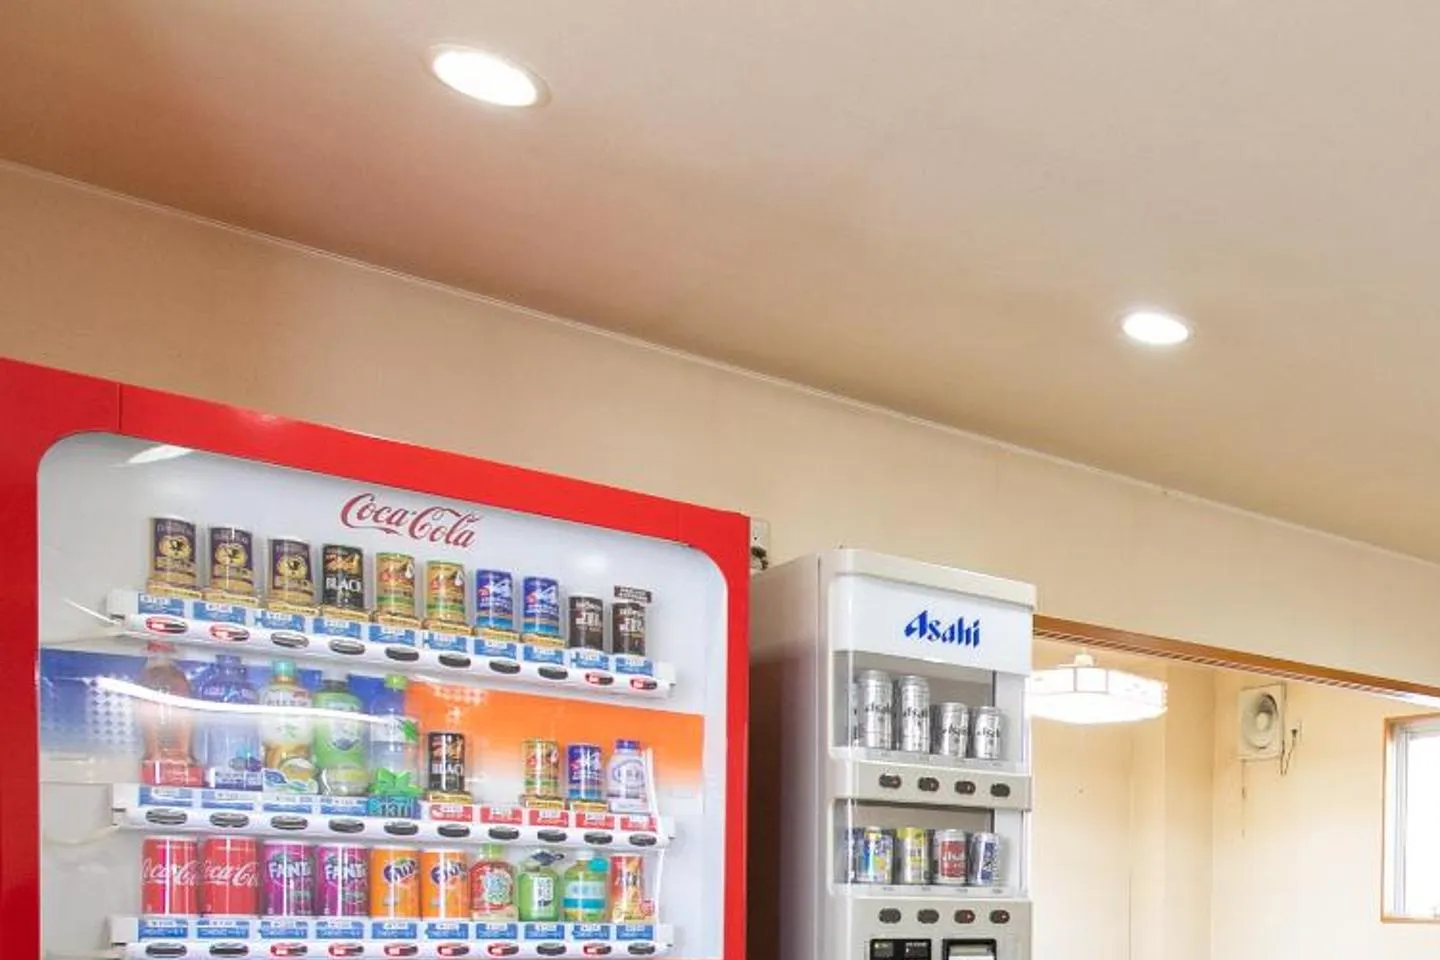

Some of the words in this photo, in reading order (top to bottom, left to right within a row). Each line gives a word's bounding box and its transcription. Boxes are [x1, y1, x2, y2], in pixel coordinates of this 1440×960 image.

[341, 493, 482, 548] Coca-Cola
[326, 576, 362, 592] BLAC
[904, 610, 980, 648] Asahi
